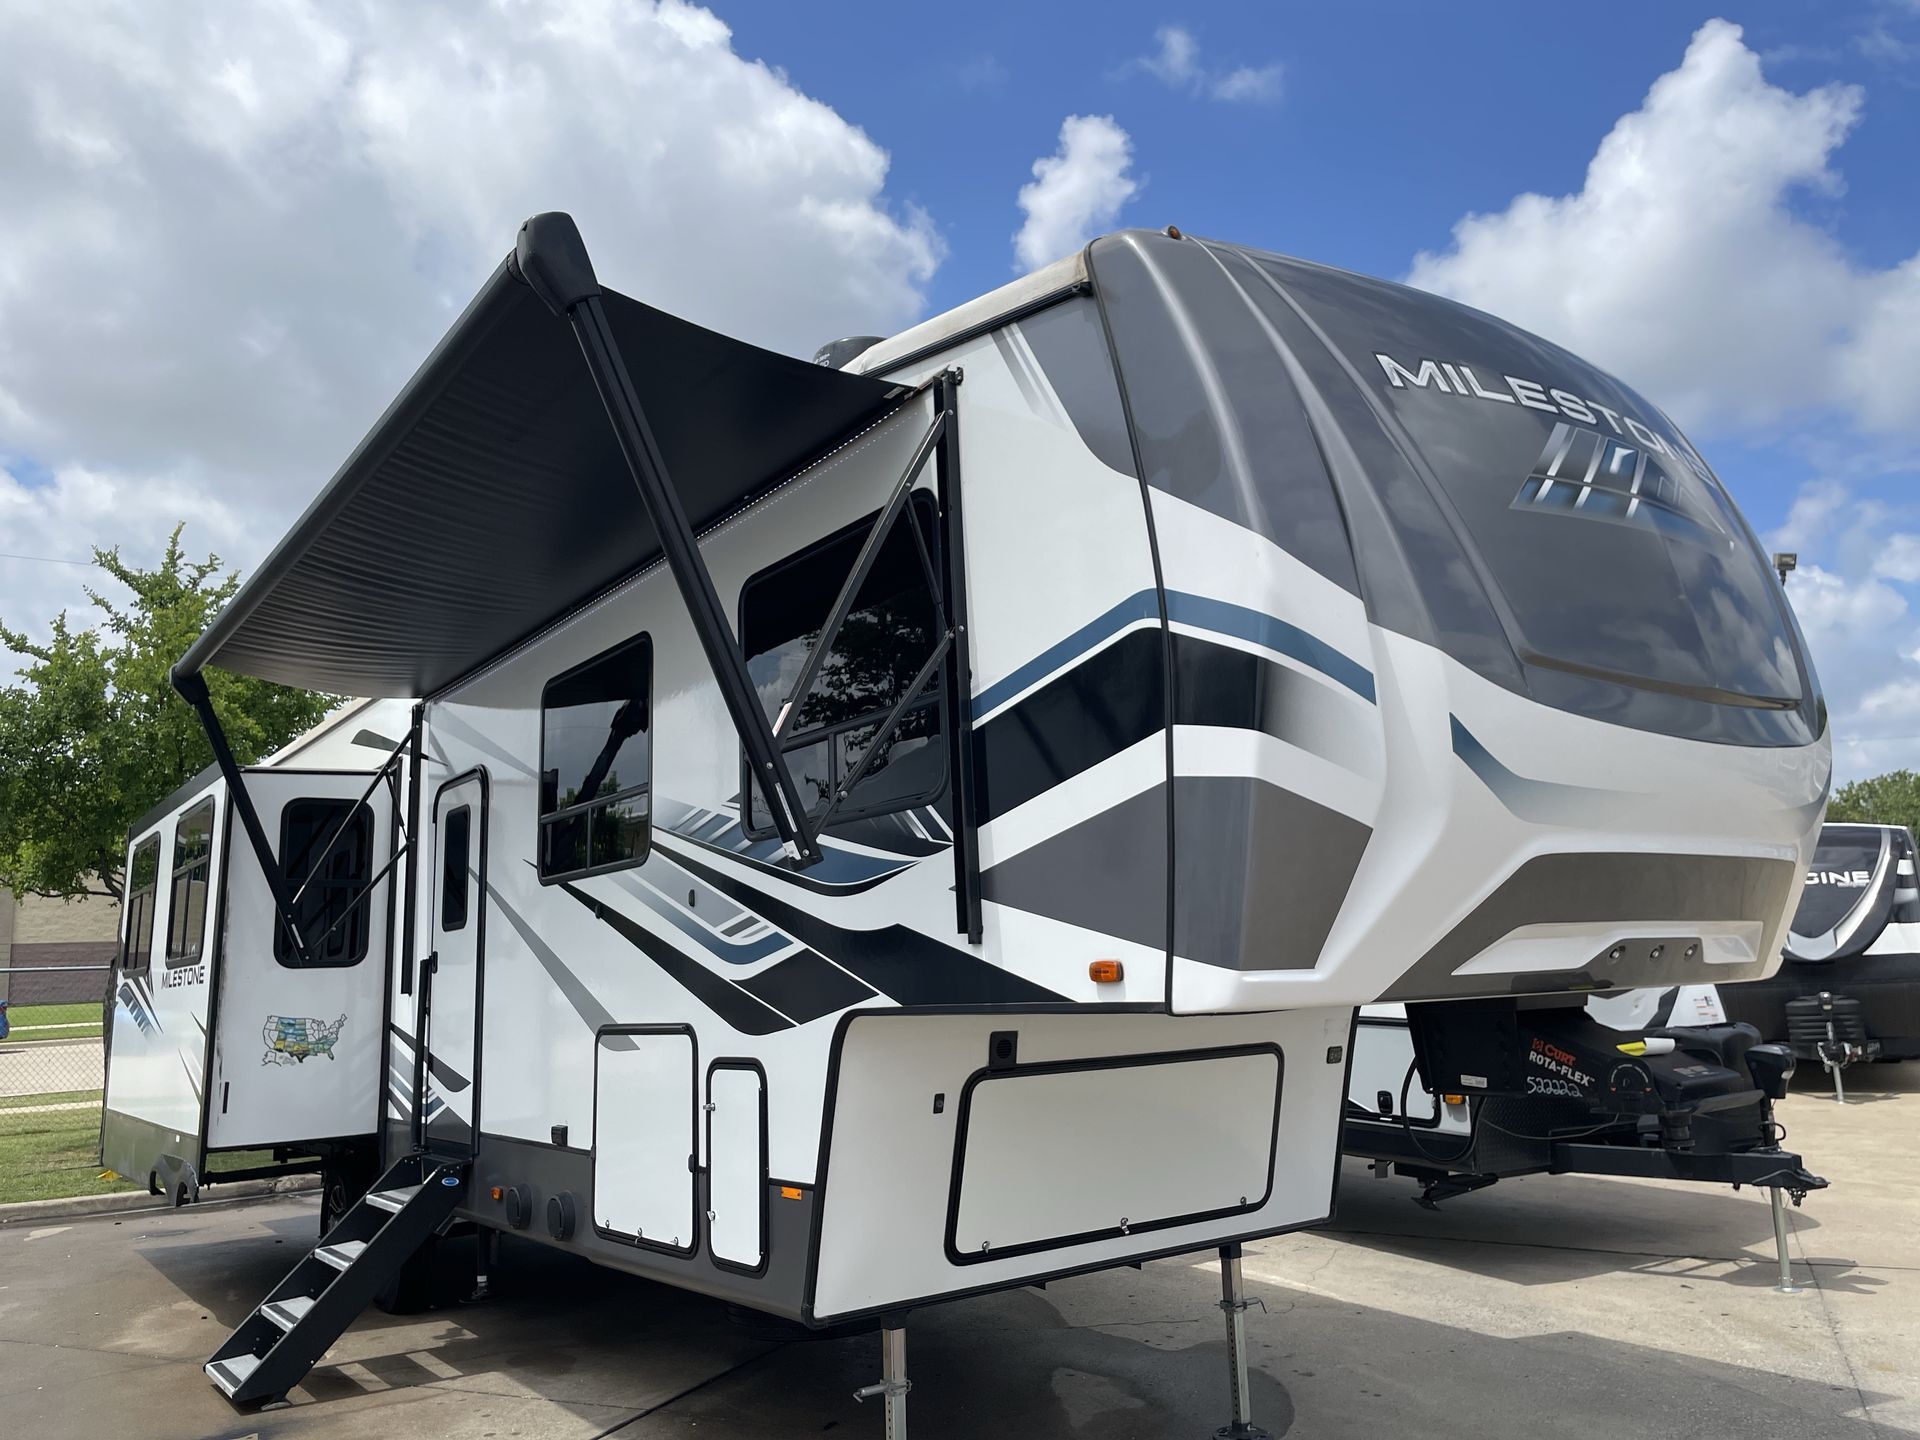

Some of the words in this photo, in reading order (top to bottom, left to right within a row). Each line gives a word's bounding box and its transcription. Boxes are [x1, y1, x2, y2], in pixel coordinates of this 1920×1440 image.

[1374, 353, 1715, 487] MILESTONE
[161, 965, 205, 989] MILESTONE
[1544, 1043, 1576, 1066] CURT
[1526, 1076, 1583, 1098] 522222
